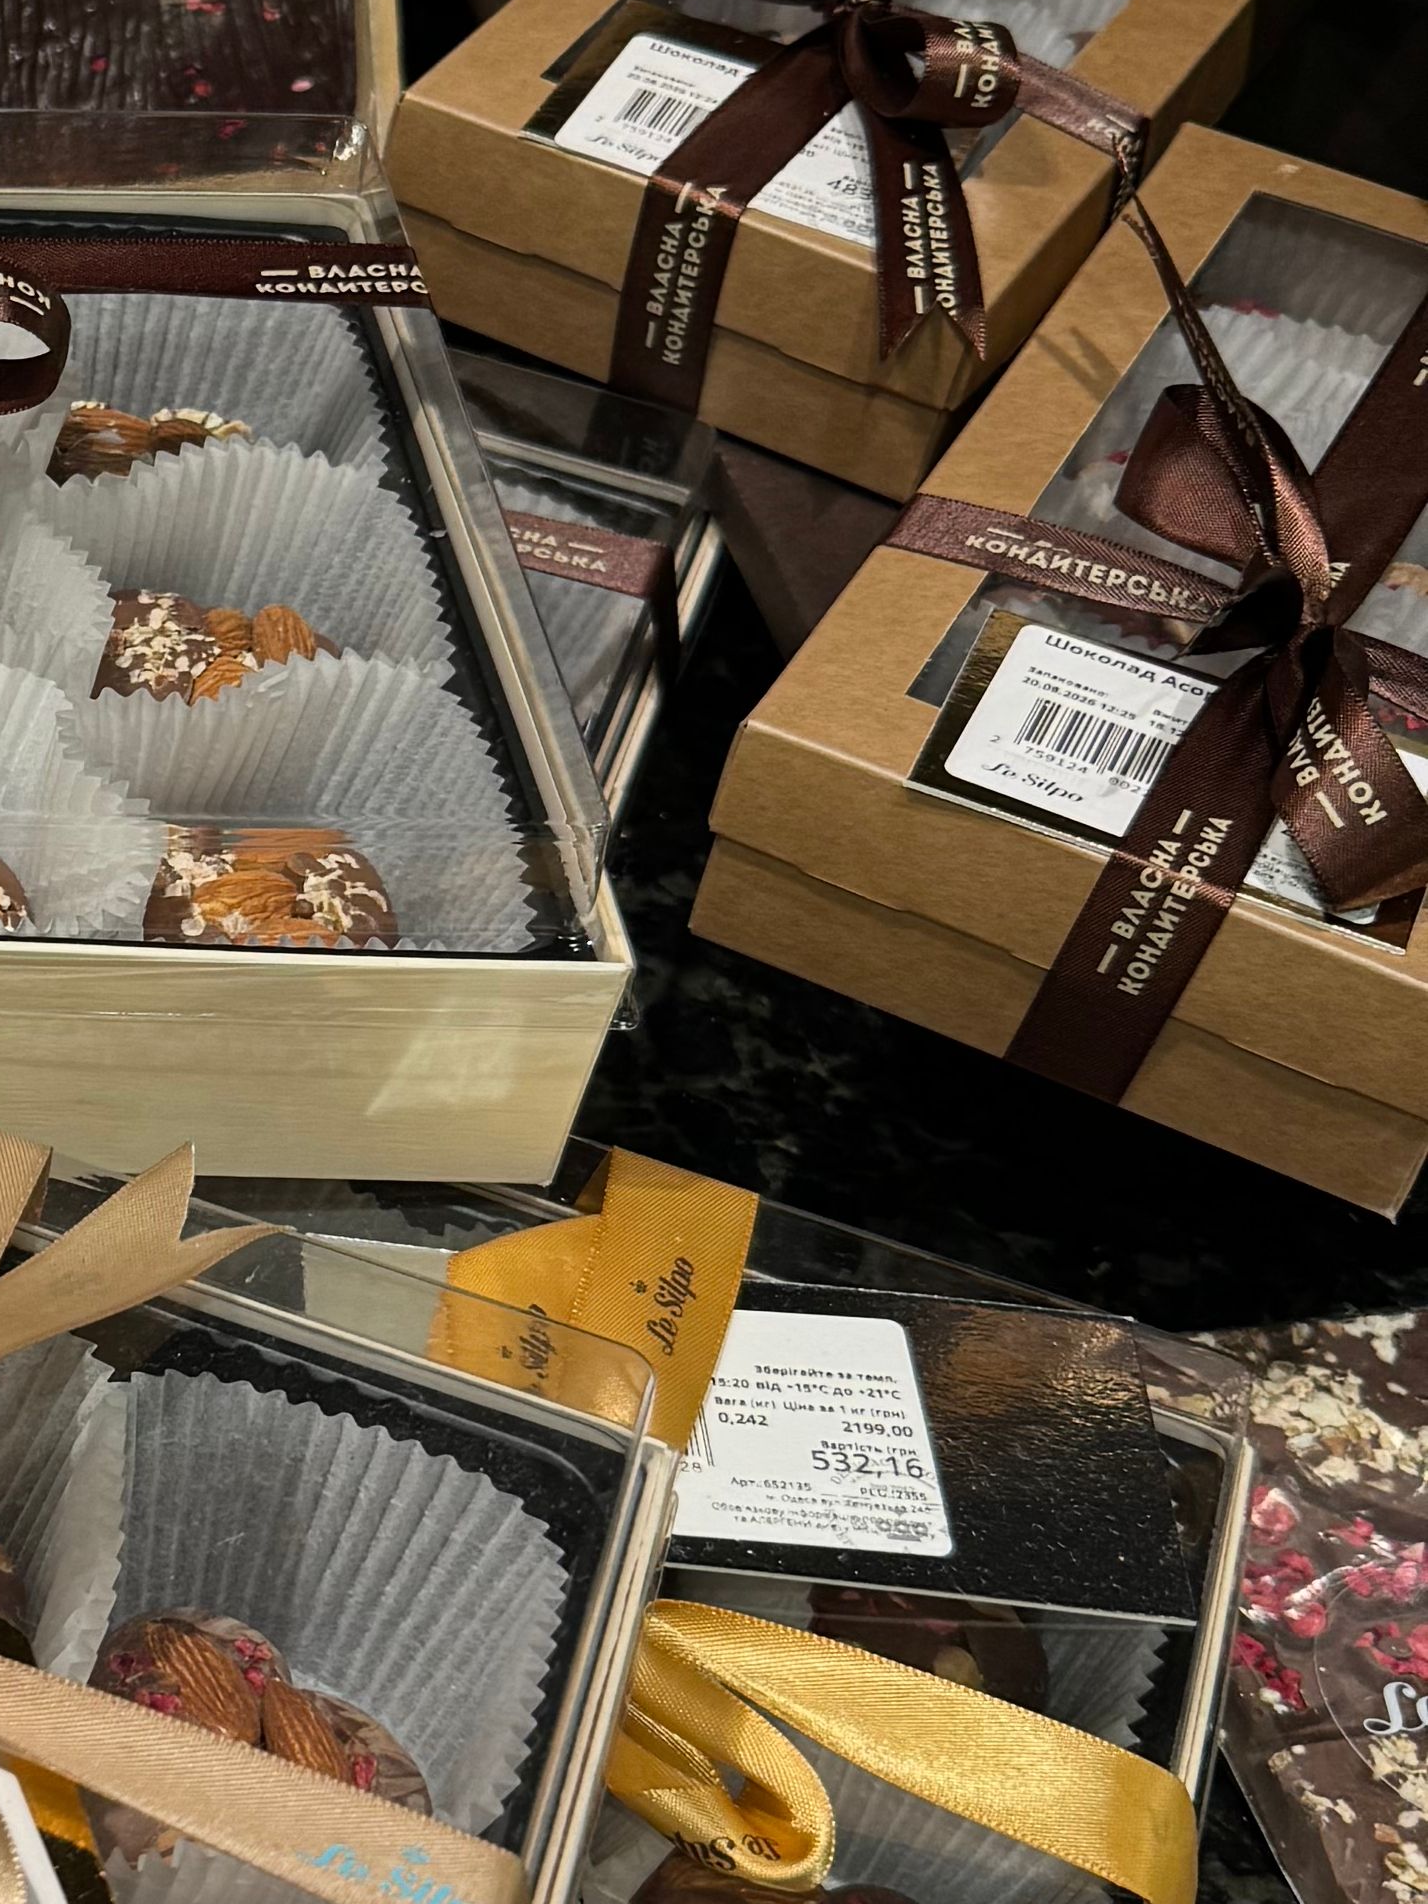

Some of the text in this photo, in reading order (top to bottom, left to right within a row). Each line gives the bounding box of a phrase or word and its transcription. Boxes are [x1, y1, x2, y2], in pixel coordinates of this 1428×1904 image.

[646, 219, 686, 317] ВЛАСНА
[662, 185, 731, 365] КОНДИТЕРСЬКА
[902, 199, 928, 280] ВЛАСНА
[1044, 634, 1156, 684] Шоколад
[981, 762, 1019, 780] Le
[1022, 772, 1085, 803] Silpo
[1110, 838, 1183, 940] ВЛАСНА
[1117, 817, 1234, 996] КОНДИТЕРСЬКА
[646, 1256, 697, 1356] Le Silpo
[811, 1449, 924, 1479] 532,16
